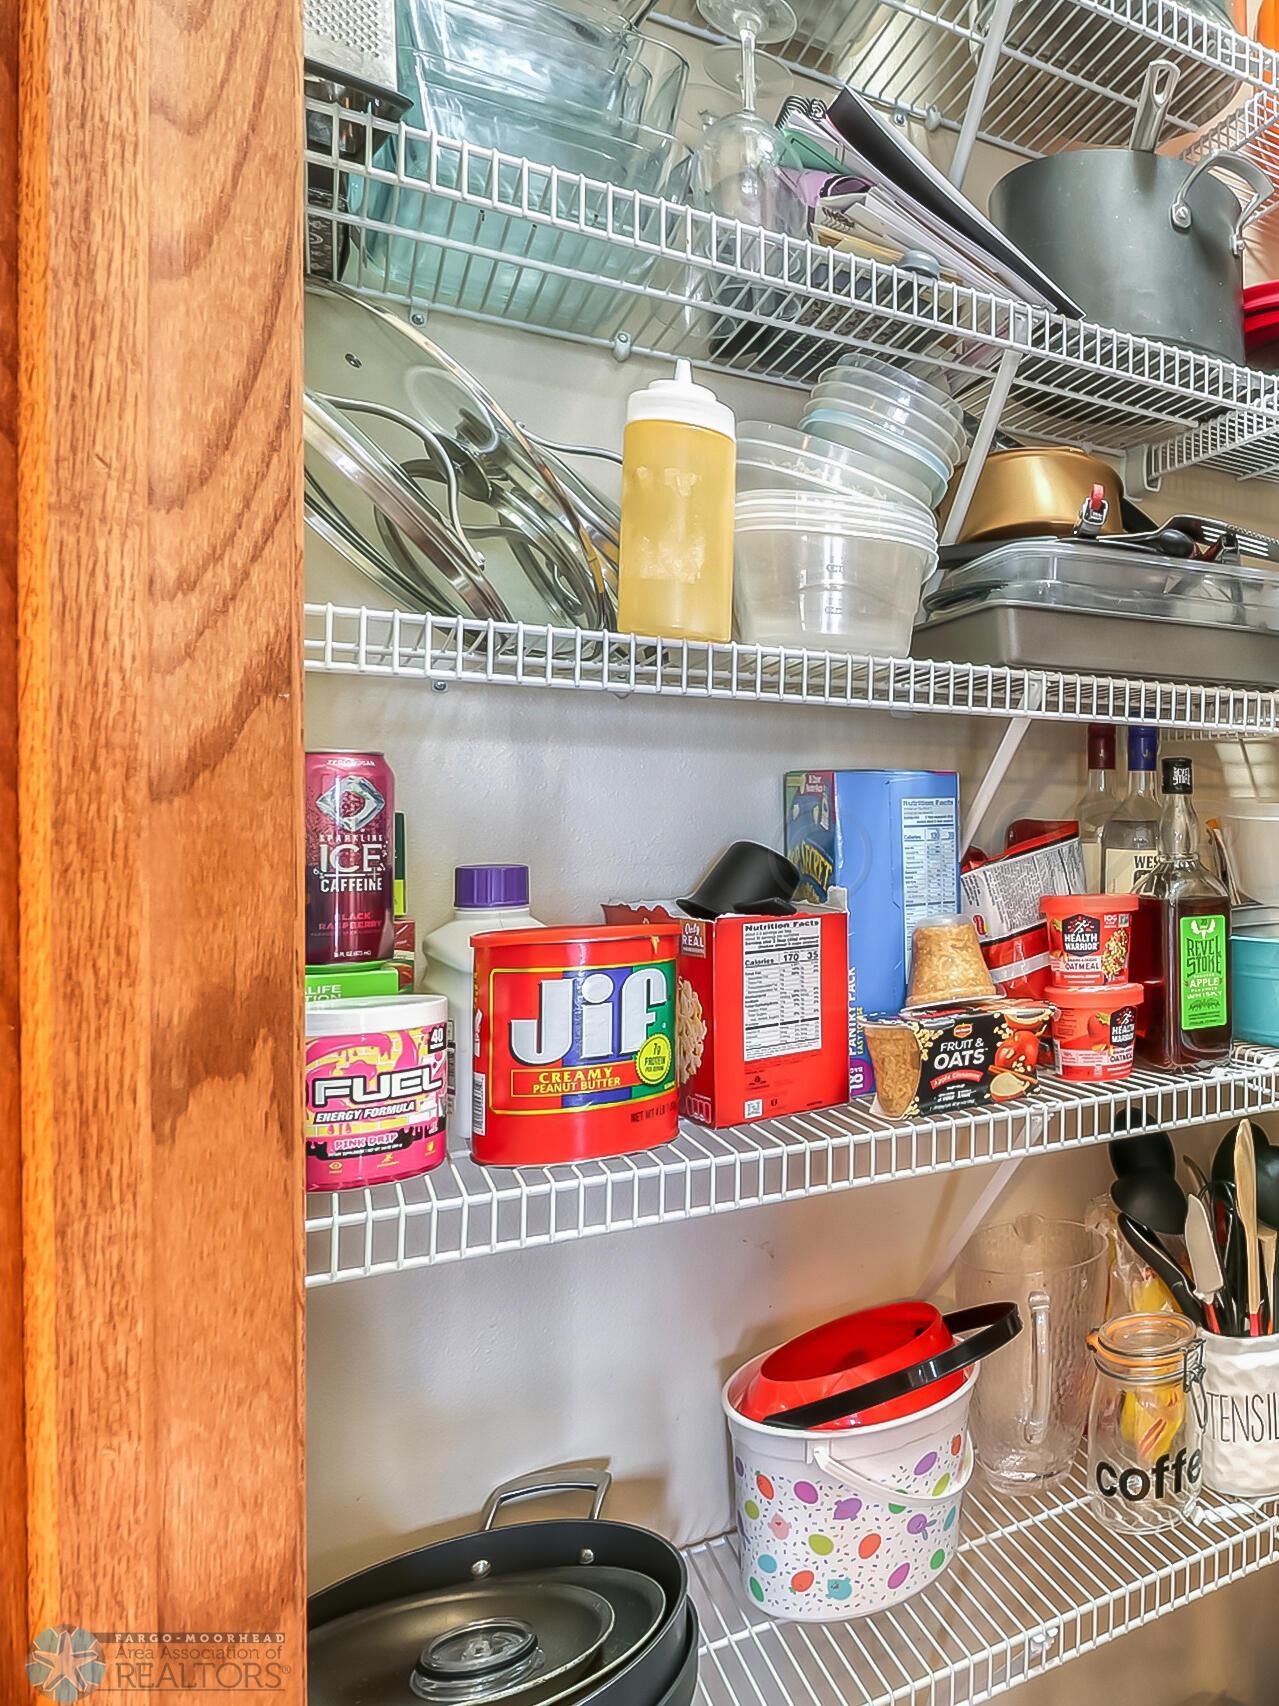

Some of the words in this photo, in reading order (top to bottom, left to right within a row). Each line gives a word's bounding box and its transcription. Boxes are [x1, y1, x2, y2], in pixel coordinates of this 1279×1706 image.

[319, 843, 384, 874] ICE
[320, 877, 383, 893] CAFFEINE
[745, 922, 790, 933] Nutrition
[792, 919, 819, 929] Facts
[682, 934, 704, 948] REAL
[1064, 933, 1098, 943] HEALTH
[1065, 942, 1099, 951] WARRIOR
[1186, 937, 1221, 957] REVEL
[745, 958, 774, 967] Calories
[783, 954, 799, 962] 170
[807, 952, 819, 960] 35
[1064, 962, 1100, 971] OATMEAL
[1186, 955, 1222, 978] STOKE
[1189, 977, 1220, 988] APPLE
[510, 968, 668, 1065] Jif
[430, 1026, 444, 1044] 40
[940, 1039, 974, 1052] FRUIT
[975, 1037, 985, 1048] &
[933, 1048, 985, 1071] OATS
[539, 1067, 613, 1084] CREAMY
[315, 1065, 442, 1106] FUEL
[532, 1082, 577, 1094] PEANUT
[580, 1077, 621, 1091] BUTTER
[316, 1110, 361, 1123] ENERGY
[364, 1102, 416, 1119] FORMULA
[334, 1137, 367, 1151] PINK
[367, 1131, 399, 1146] DRIP
